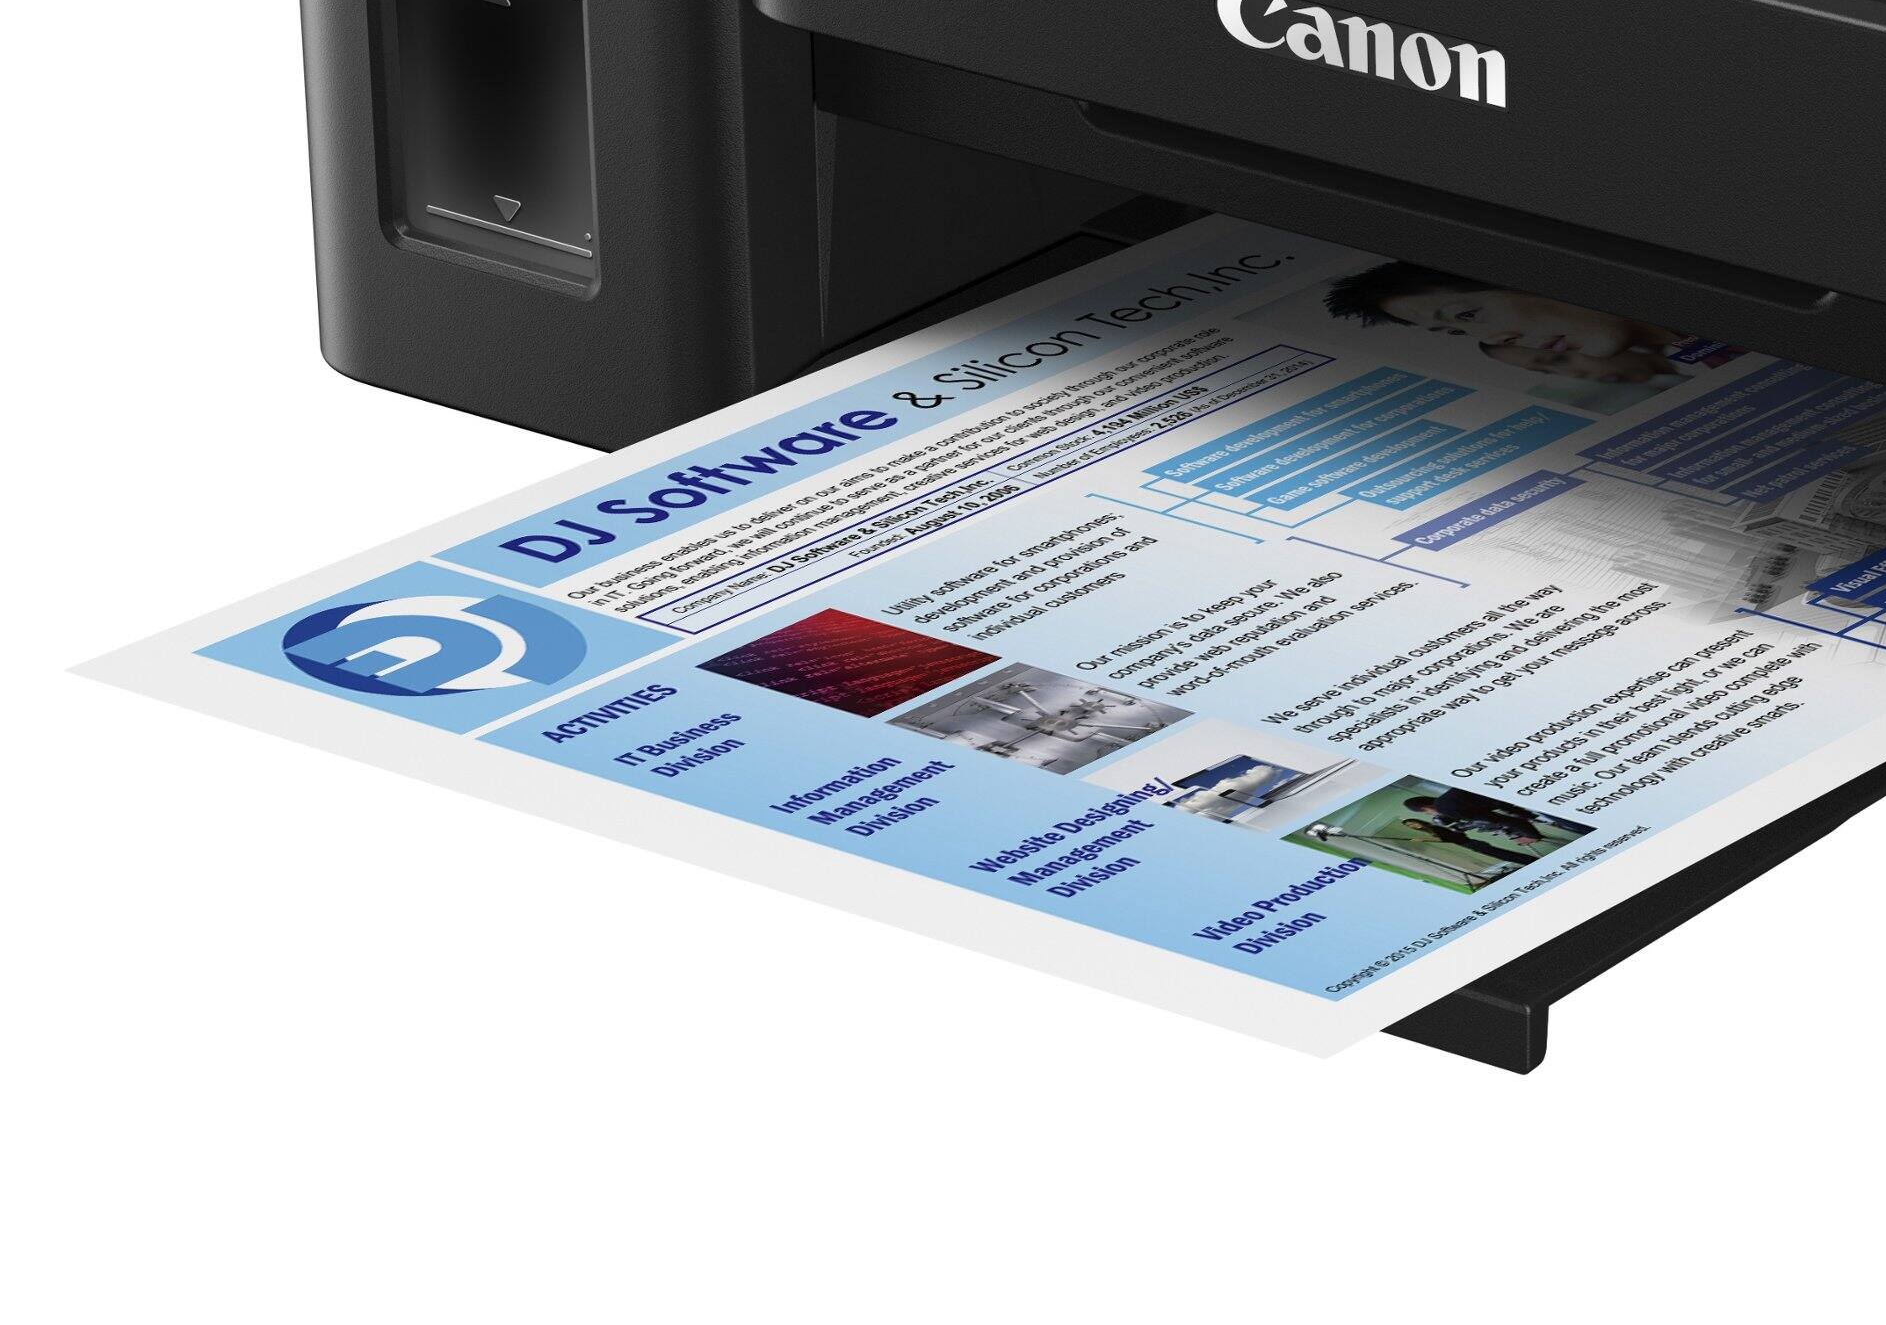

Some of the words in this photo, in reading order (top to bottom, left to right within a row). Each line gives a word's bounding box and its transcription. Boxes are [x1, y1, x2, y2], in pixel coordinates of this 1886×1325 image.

[498, 519, 616, 563] DJ
[596, 410, 898, 524] Software
[892, 391, 956, 409] &
[933, 330, 1101, 390] Silicon
[1074, 255, 1295, 329] Tech,Inc.
[1006, 450, 1061, 471] Common
[1055, 435, 1095, 450] Stock:
[1091, 418, 1133, 436] 4,194
[1126, 399, 1179, 420] Million
[1172, 386, 1209, 400] US$
[848, 532, 910, 558] Founded:
[904, 510, 963, 535] August
[957, 502, 988, 511] 10,
[979, 485, 1021, 502] 2006
[1414, 514, 1486, 544] Corporate
[1479, 500, 1517, 516] data
[1510, 477, 1567, 502] security
[672, 589, 733, 614] Company
[727, 571, 777, 590] Name:
[766, 561, 795, 573] DJ
[790, 534, 862, 563] Software
[871, 506, 929, 529] Silicon
[881, 595, 935, 615] Utility
[930, 566, 999, 596] software
[992, 555, 1021, 567] for
[915, 579, 1016, 624] development
[1012, 565, 1046, 581] and
[1043, 537, 1114, 569] provision
[1110, 527, 1131, 537] of
[942, 602, 1012, 632] software
[1005, 591, 1034, 603] for
[1033, 551, 1128, 592] corporations
[1124, 536, 1158, 552] and
[1830, 570, 1883, 592] Visual
[967, 606, 1048, 641] individual
[1045, 572, 1126, 608] customers
[1076, 655, 1113, 670] Our
[1110, 629, 1173, 657] mission
[1164, 621, 1189, 630] is
[1181, 613, 1206, 622] to
[1198, 596, 1244, 614] keep
[1239, 579, 1277, 598] your
[1137, 661, 1199, 689] provide
[1194, 645, 1232, 661] web
[1228, 611, 1307, 646] reputation
[1303, 595, 1337, 612] and
[1166, 646, 1280, 696] word-of-mouth
[1275, 610, 1354, 646] evaluation
[1350, 582, 1418, 611] services.
[1189, 625, 1228, 642] data
[1224, 602, 1284, 626] secure.
[1274, 587, 1311, 600] We
[1307, 572, 1343, 588] also
[1261, 711, 1299, 724] We
[1295, 690, 1342, 711] serve
[1333, 655, 1412, 691] individual
[1408, 621, 1487, 657] customers
[1482, 610, 1506, 622] all
[1498, 600, 1530, 613] the
[1525, 585, 1563, 600] way
[1293, 705, 1360, 733] through
[1351, 696, 1377, 705] to
[1372, 674, 1419, 697] major
[1416, 633, 1513, 676] corporations.
[1503, 618, 1539, 631] We
[1535, 605, 1565, 619] are
[1327, 704, 1409, 742] specialists
[1400, 696, 1426, 705] in
[1416, 660, 1503, 697] identifying
[1495, 644, 1529, 661] and
[1524, 613, 1601, 647] delivering
[1589, 601, 1621, 614] the
[1617, 583, 1659, 602] most
[1358, 709, 1446, 751] appropriate
[1441, 693, 1480, 709] way
[1470, 685, 1495, 694] to
[1491, 672, 1522, 687] get
[1515, 655, 1554, 675] your
[1549, 625, 1619, 657] message
[1615, 601, 1671, 626] across.
[541, 684, 678, 744] ACTIVITIES
[613, 752, 647, 766] IT
[635, 713, 742, 757] Business
[1451, 761, 1488, 778] Our
[1483, 742, 1530, 762] video
[1525, 704, 1607, 744] production
[1602, 671, 1671, 704] expertise
[1667, 657, 1700, 672] can
[1694, 630, 1754, 659] present
[1484, 768, 1523, 789] your
[1520, 737, 1589, 771] products
[1578, 729, 1605, 738] in
[1595, 711, 1637, 730] their
[1629, 694, 1672, 713] best
[1661, 678, 1709, 696] light,
[1702, 668, 1723, 678] or
[1718, 657, 1746, 669] we
[1742, 643, 1775, 658] can
[1517, 771, 1569, 796] create
[1573, 751, 1606, 765] full
[1601, 708, 1690, 755] promotional
[1683, 690, 1729, 710] video
[1725, 658, 1792, 691] complete
[1786, 643, 1822, 658] with
[1547, 781, 1602, 805] music.
[1594, 763, 1630, 779] Our
[1623, 744, 1671, 765] team
[1660, 720, 1719, 745] blends
[1714, 695, 1771, 720] cutting
[1762, 677, 1803, 696] edge
[650, 739, 746, 778] Division
[769, 757, 902, 814] Information
[807, 761, 955, 825] Management
[1575, 772, 1666, 814] technology
[1657, 757, 1696, 773] with
[1690, 727, 1752, 757] creative
[1746, 702, 1805, 728] smarts.
[845, 797, 940, 837] Division
[968, 832, 1066, 873] Website
[1052, 778, 1172, 834] Designing/
[1007, 819, 1155, 886] Management
[1046, 857, 1141, 898] Division
[1192, 911, 1265, 941] Video
[1251, 854, 1373, 913] Production
[1325, 966, 1381, 993] Copyright
[1385, 946, 1417, 962] 2015
[1411, 938, 1433, 948] DJ
[1427, 916, 1478, 940] Software
[1481, 893, 1520, 911] Silicon
[1560, 861, 1580, 871] All
[1575, 848, 1607, 863] rights
[1603, 825, 1652, 849] reserved.
[1232, 913, 1327, 955] Division
